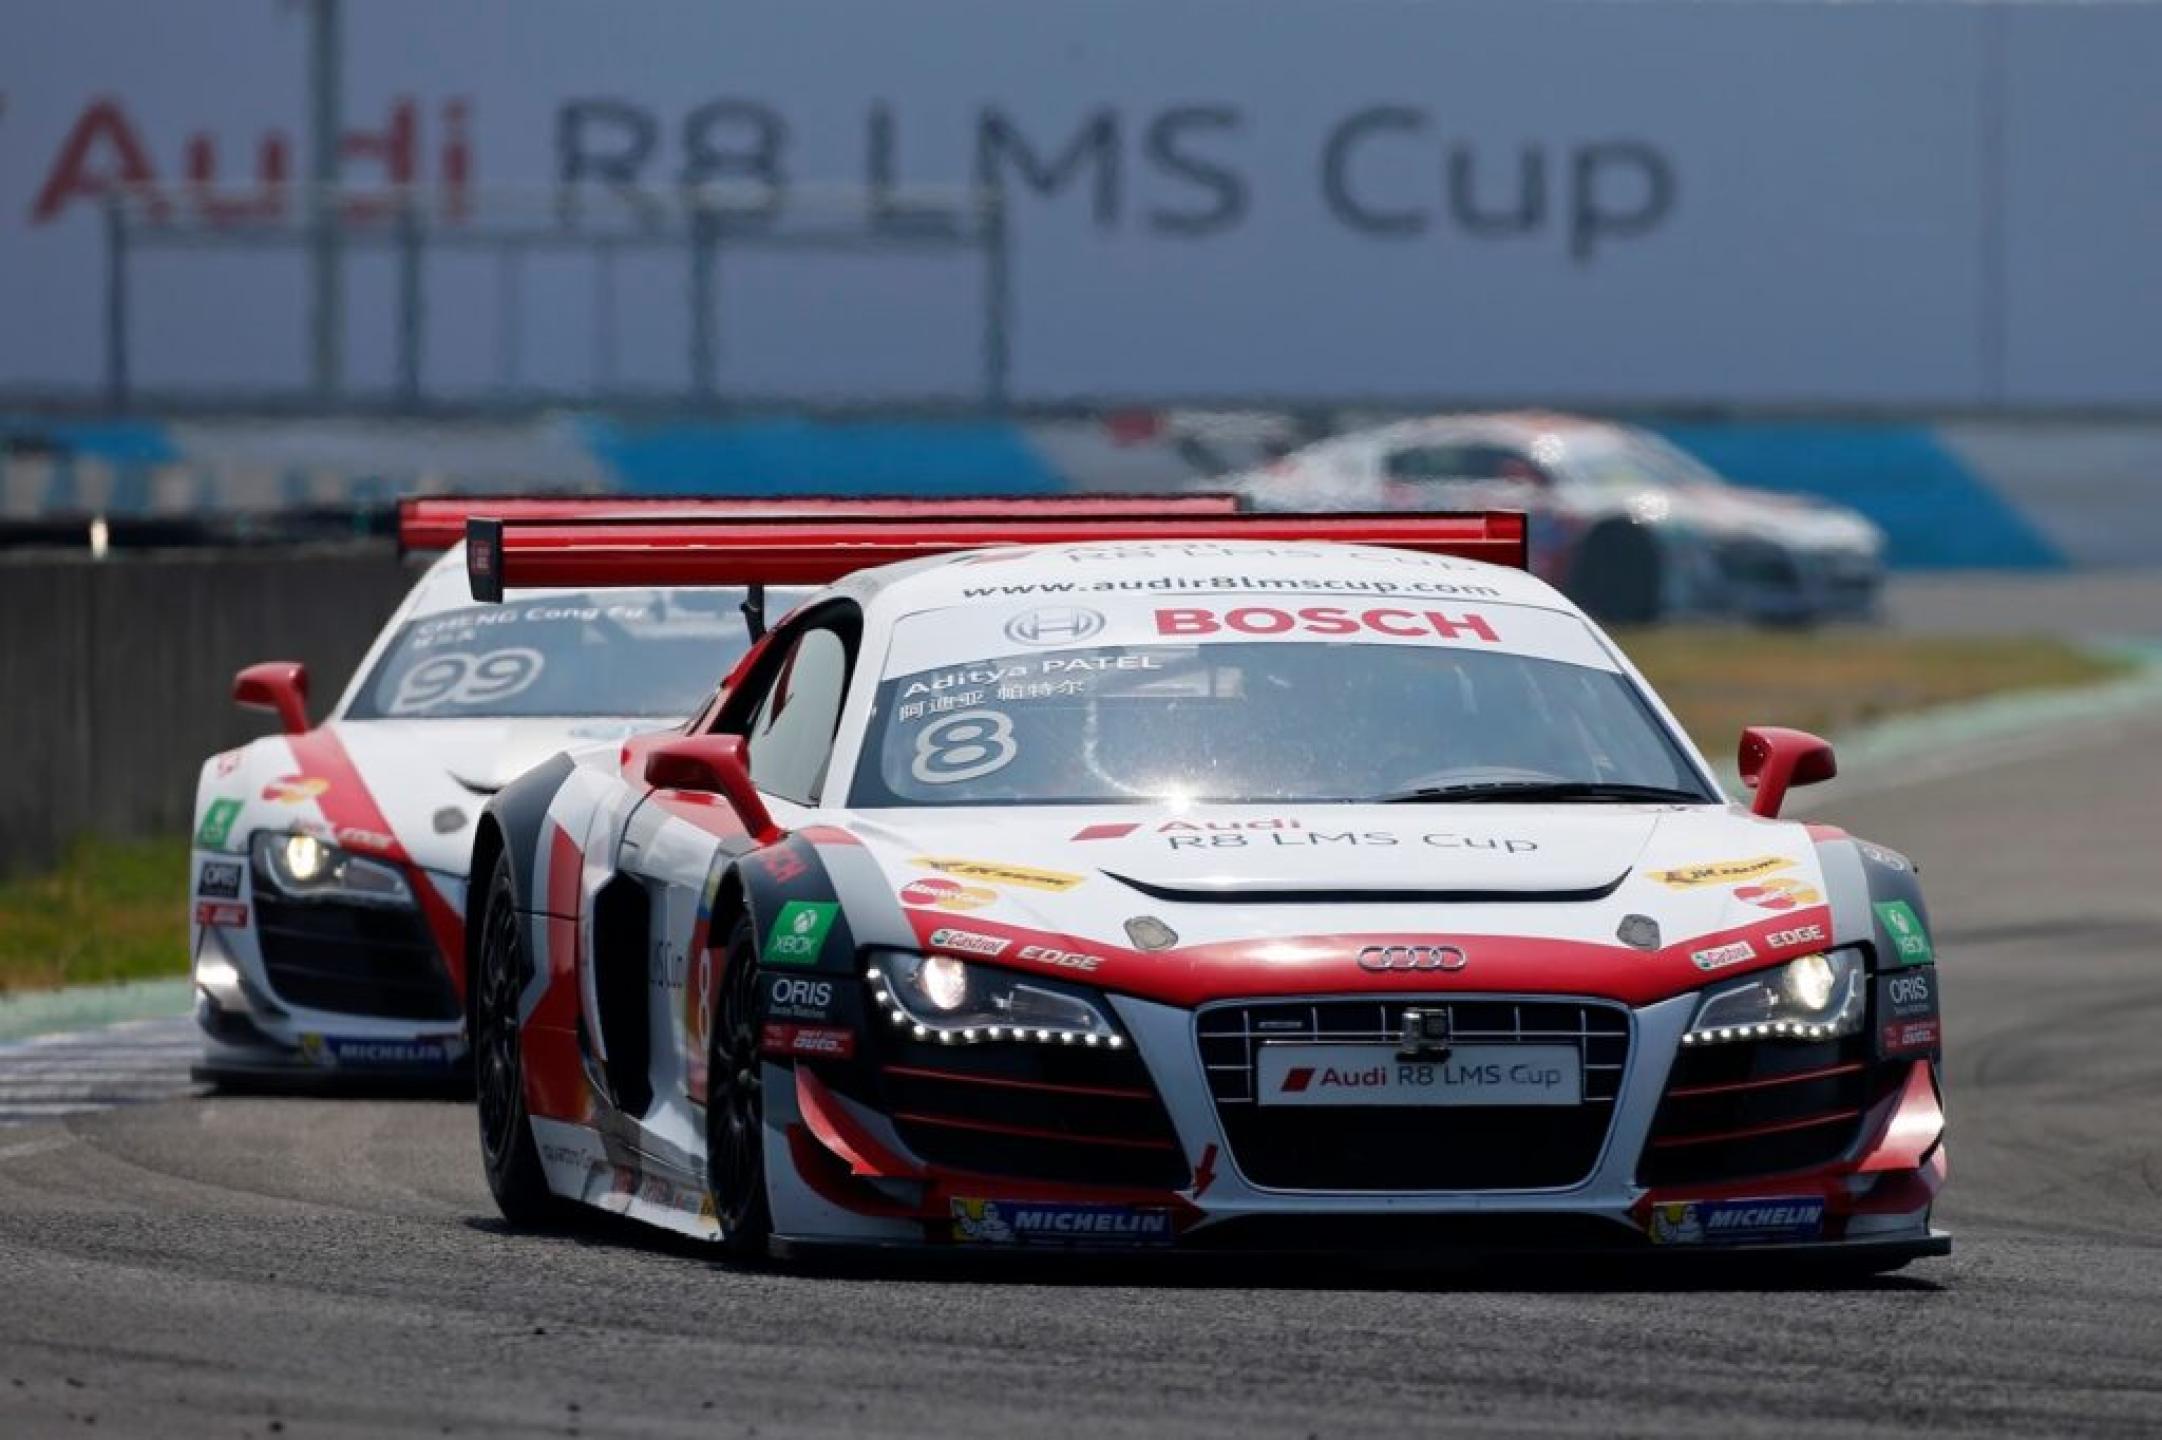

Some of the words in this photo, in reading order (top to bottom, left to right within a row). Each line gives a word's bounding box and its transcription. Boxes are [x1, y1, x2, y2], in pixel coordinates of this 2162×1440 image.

[27, 97, 470, 228] Audi
[556, 97, 792, 230] R8
[865, 98, 1252, 242] LMS
[1318, 103, 1679, 264] Cup
[962, 576, 1500, 598] www.audir8lmscup.com
[1154, 606, 1502, 642] BOSCH
[391, 647, 545, 714] 99
[903, 665, 1028, 697] Aditya
[1042, 655, 1163, 674] PATEL
[911, 708, 1018, 785] 8
[1156, 818, 1301, 832] Audi
[1168, 832, 1249, 851] R8
[1272, 832, 1399, 846] LMS
[1422, 832, 1539, 854] Cup
[772, 934, 817, 956] XBOX
[1766, 924, 1826, 948] EDGE
[1017, 945, 1104, 971] EDGE
[772, 978, 833, 1006] ORIS
[1889, 974, 1929, 1003] ORIS
[1320, 1065, 1387, 1086] Audi
[1397, 1066, 1435, 1085] R8
[1443, 1065, 1501, 1085] LMS
[1508, 1065, 1562, 1090] Cup
[1013, 1210, 1167, 1232] MICHELIN
[1708, 1205, 1823, 1228] MICHELIN
